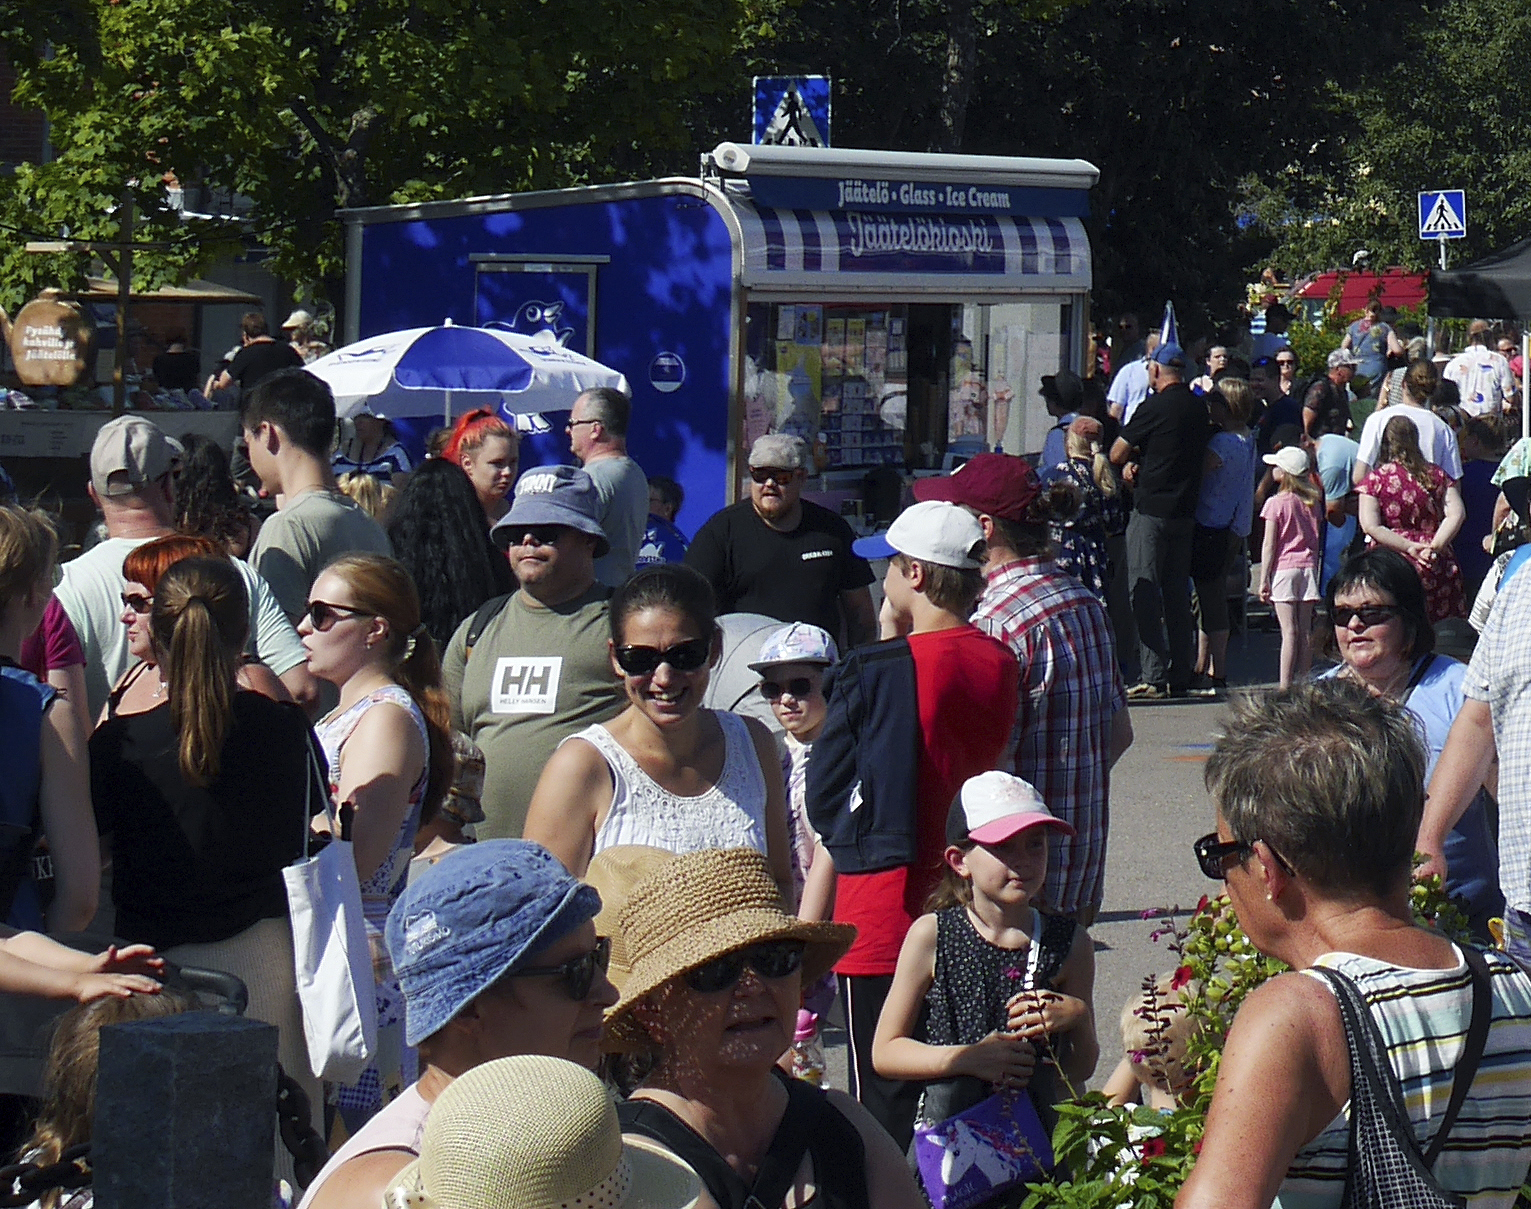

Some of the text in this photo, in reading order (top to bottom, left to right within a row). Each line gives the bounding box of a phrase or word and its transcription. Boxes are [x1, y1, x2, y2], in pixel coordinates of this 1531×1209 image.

[838, 180, 1011, 208] Jäätelö Glass Ice Cream
[847, 211, 993, 257] Jäätelökioski
[500, 665, 552, 696] HH
